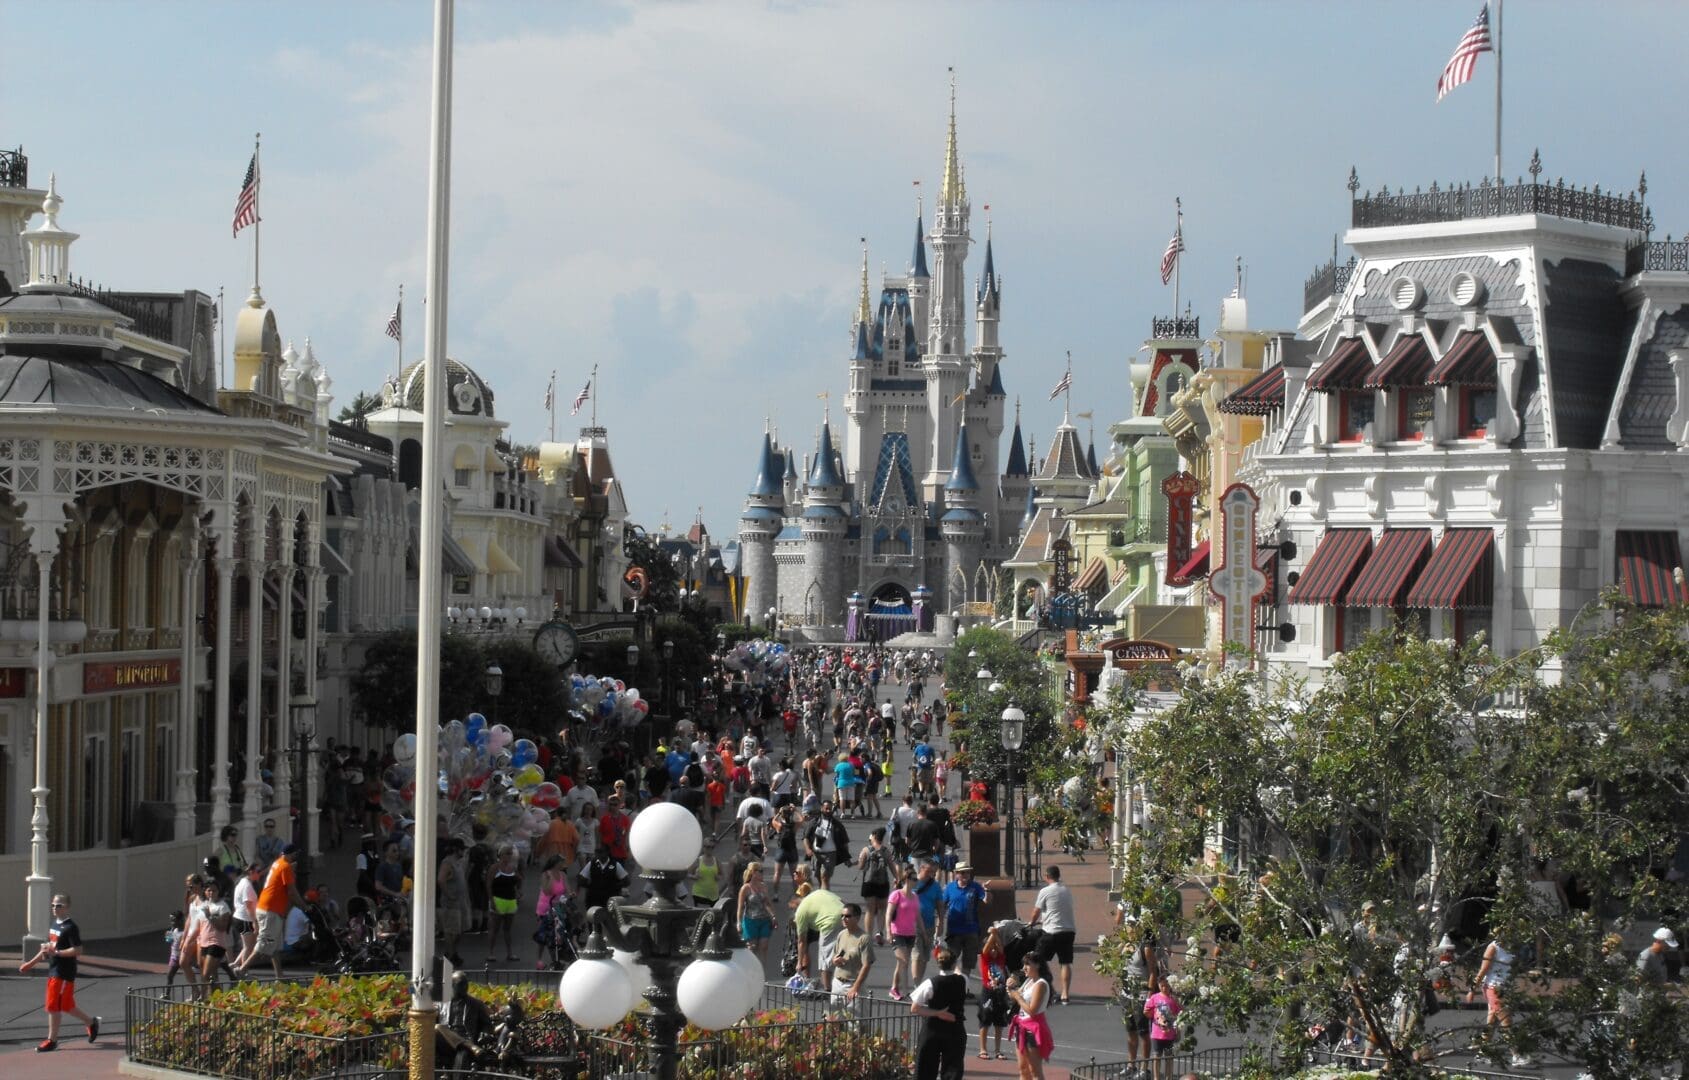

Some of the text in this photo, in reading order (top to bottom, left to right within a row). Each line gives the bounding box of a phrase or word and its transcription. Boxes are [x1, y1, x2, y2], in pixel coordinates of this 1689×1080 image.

[1057, 550, 1066, 587] CRYSTAL
[1232, 503, 1246, 660] CONFECTIONE
[1115, 648, 1170, 659] CINEMA
[116, 663, 169, 685] EMPORIUM
